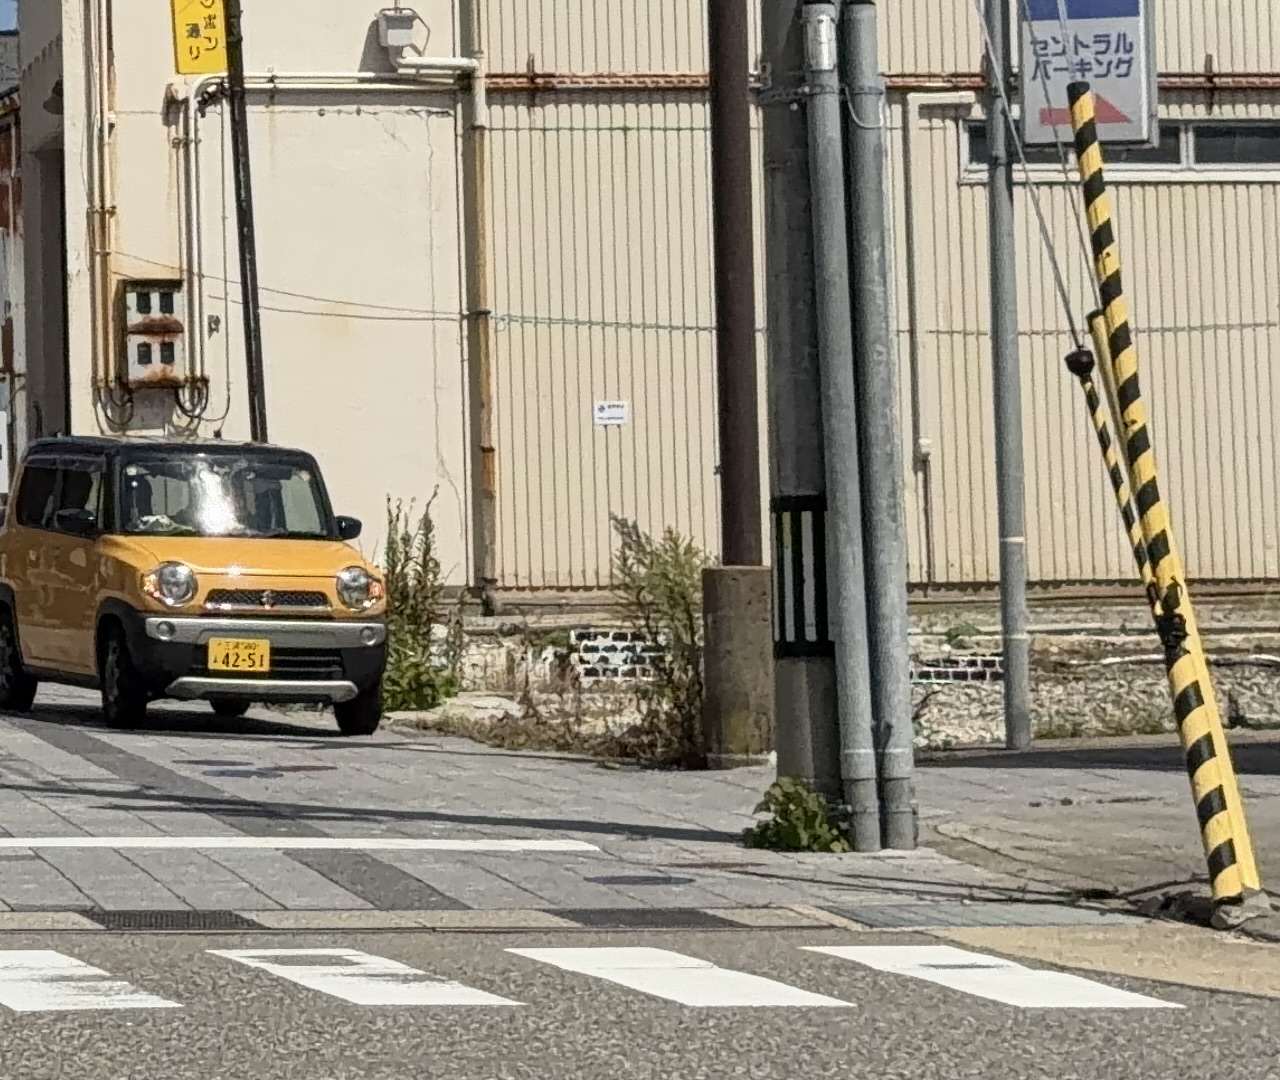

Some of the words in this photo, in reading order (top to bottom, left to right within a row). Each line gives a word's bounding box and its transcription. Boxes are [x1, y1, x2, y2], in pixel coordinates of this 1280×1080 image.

[1030, 31, 1134, 58] セントラル
